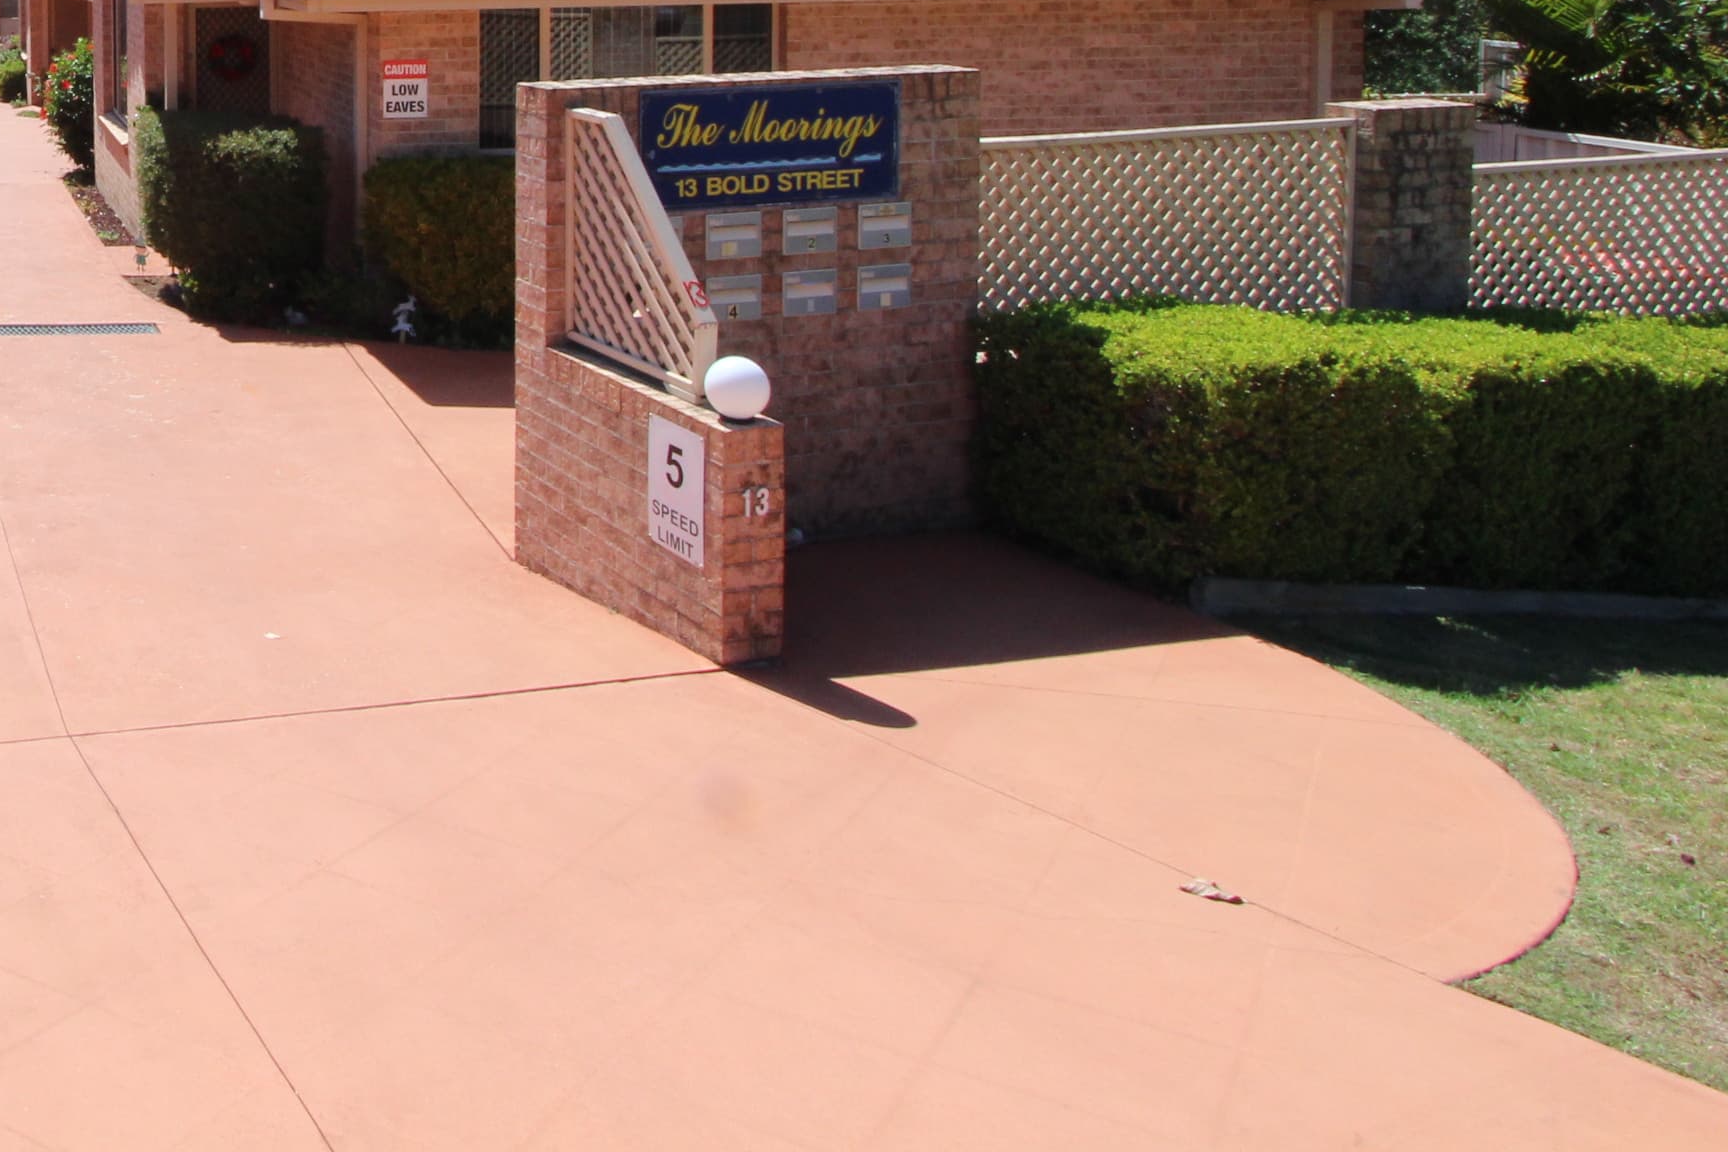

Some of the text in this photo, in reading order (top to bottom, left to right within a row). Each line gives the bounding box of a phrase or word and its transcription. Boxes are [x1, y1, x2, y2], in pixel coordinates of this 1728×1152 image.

[384, 64, 426, 75] CAUTION
[391, 84, 419, 96] LOW
[386, 100, 425, 112] EAVES
[657, 100, 883, 158] The Moorings
[675, 169, 864, 198] 13 BOLD STREET
[882, 232, 891, 244] 3
[729, 304, 738, 319] 4
[666, 444, 684, 489] 5
[742, 487, 770, 518] 13
[652, 499, 699, 537] SPEED
[657, 526, 694, 558] LIMIT
